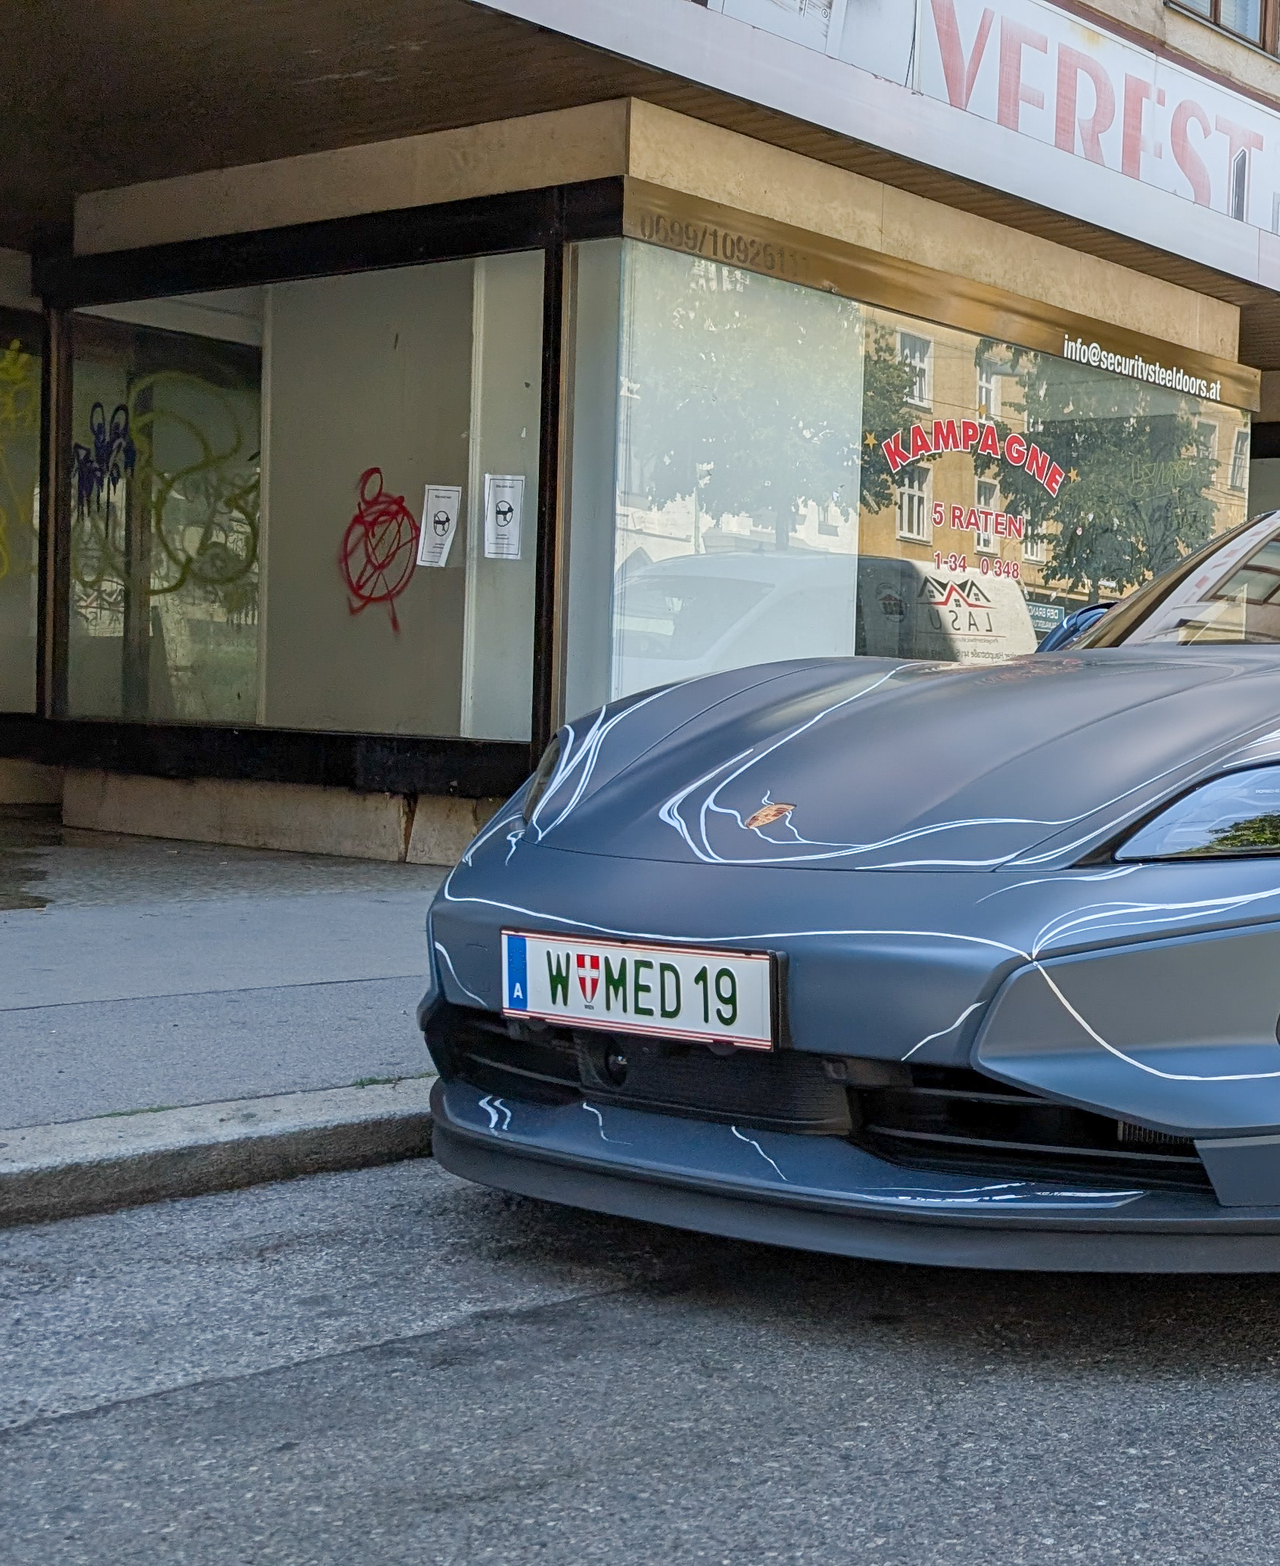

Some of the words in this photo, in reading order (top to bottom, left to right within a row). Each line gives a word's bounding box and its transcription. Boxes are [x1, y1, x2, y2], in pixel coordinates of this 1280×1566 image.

[882, 419, 1065, 498] KAMPAGNE
[932, 501, 945, 527] 5
[950, 504, 1024, 539] RATEN
[513, 983, 523, 999] A
[546, 949, 571, 1006] W
[604, 955, 682, 1018] MED
[694, 965, 738, 1026] 19
